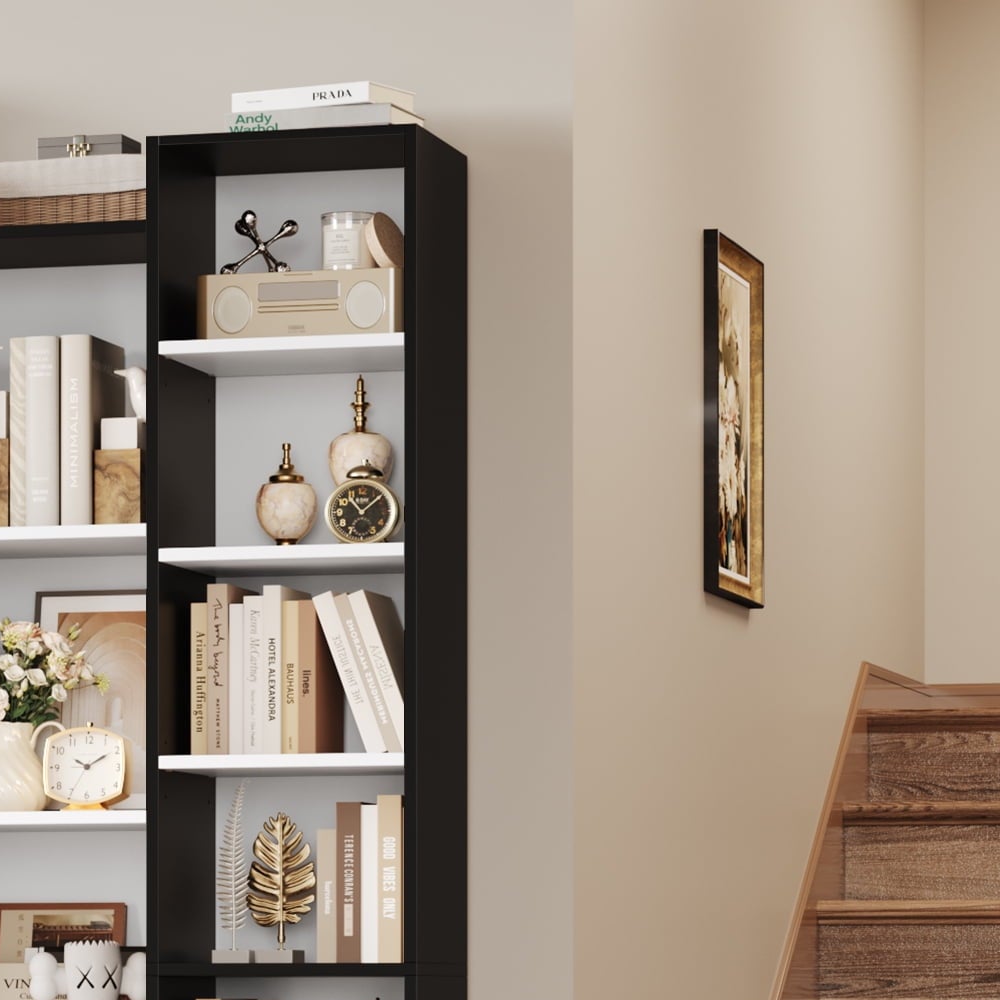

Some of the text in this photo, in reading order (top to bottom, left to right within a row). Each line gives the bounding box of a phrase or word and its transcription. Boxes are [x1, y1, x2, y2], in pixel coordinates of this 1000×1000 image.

[312, 89, 352, 101] PRADA
[235, 112, 272, 125] Andy
[69, 377, 78, 488] MINIMALISM
[193, 631, 206, 733] Arianna Huffington
[268, 637, 276, 722] HOTEL ALEXANDRA
[286, 663, 294, 705] BAUHAUS
[69, 736, 76, 747] 11
[85, 735, 94, 745] 12
[56, 746, 65, 755] 10
[114, 746, 120, 755] 2
[54, 764, 60, 772] 9
[116, 763, 121, 772] 3
[56, 781, 62, 790] 8
[84, 790, 90, 799] 6
[101, 787, 106, 797] 5
[344, 834, 354, 867] TERENCE
[383, 836, 396, 920] GOOD VIBES ONLY
[344, 868, 354, 902] CONRAN'S
[4, 978, 31, 989] VIN
